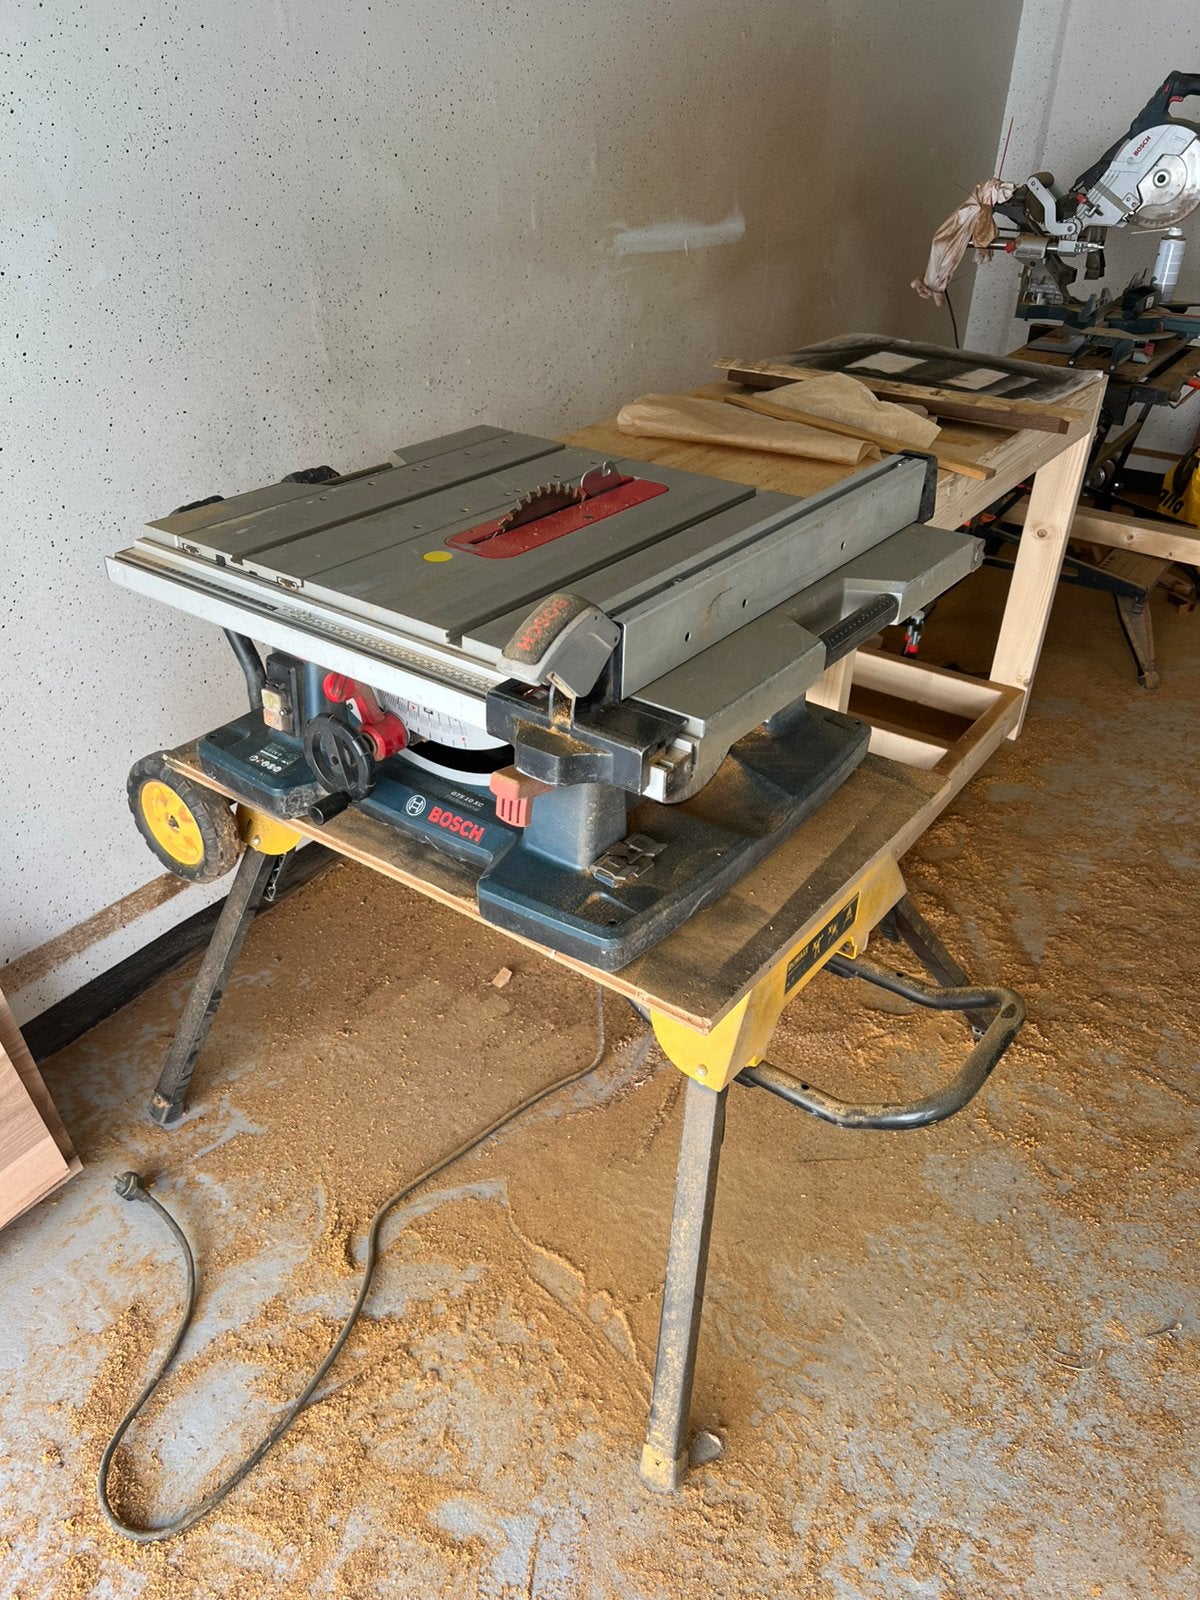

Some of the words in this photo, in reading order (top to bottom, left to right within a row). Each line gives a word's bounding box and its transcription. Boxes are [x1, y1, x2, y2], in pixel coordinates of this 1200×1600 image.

[1133, 135, 1151, 157] BOSCH
[516, 599, 570, 652] BOSCH
[464, 795, 474, 803] 10
[473, 799, 485, 808] XC
[427, 806, 486, 843] BOSCH
